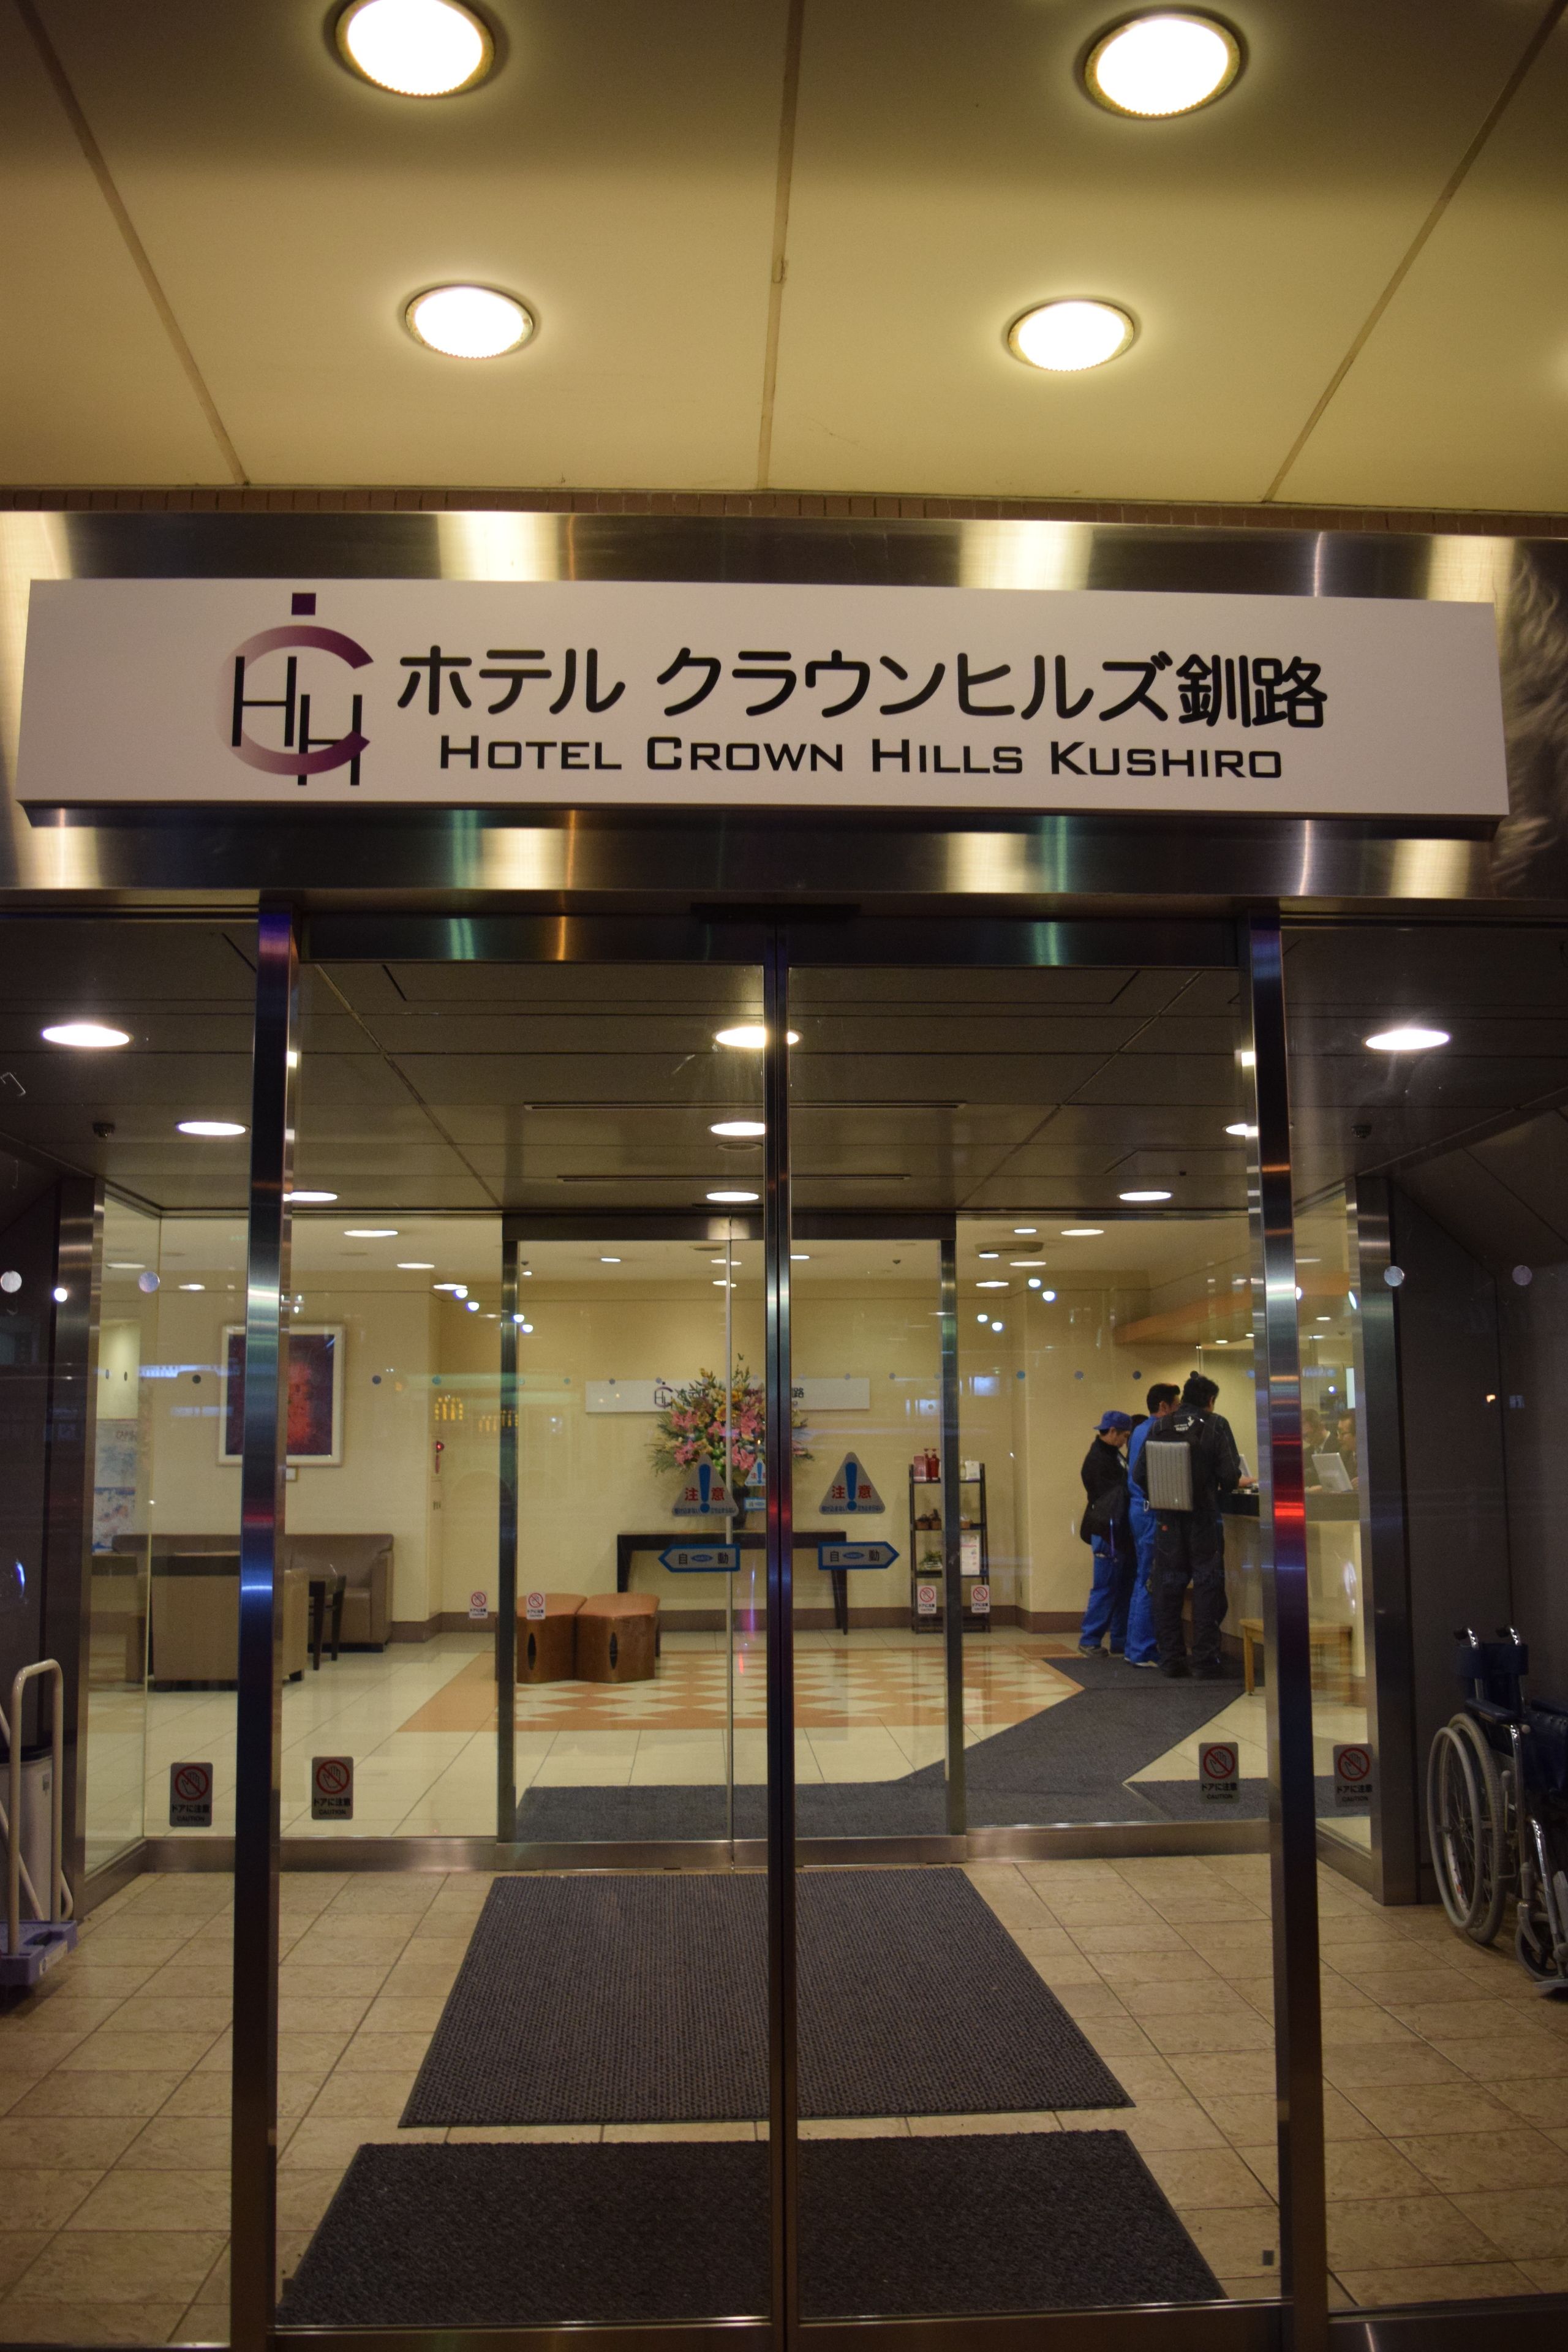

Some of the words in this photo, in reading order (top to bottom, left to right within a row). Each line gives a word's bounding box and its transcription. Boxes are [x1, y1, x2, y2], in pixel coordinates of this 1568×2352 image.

[398, 644, 626, 716] ホテル
[657, 647, 1328, 729] クラウンヒルズ釧路
